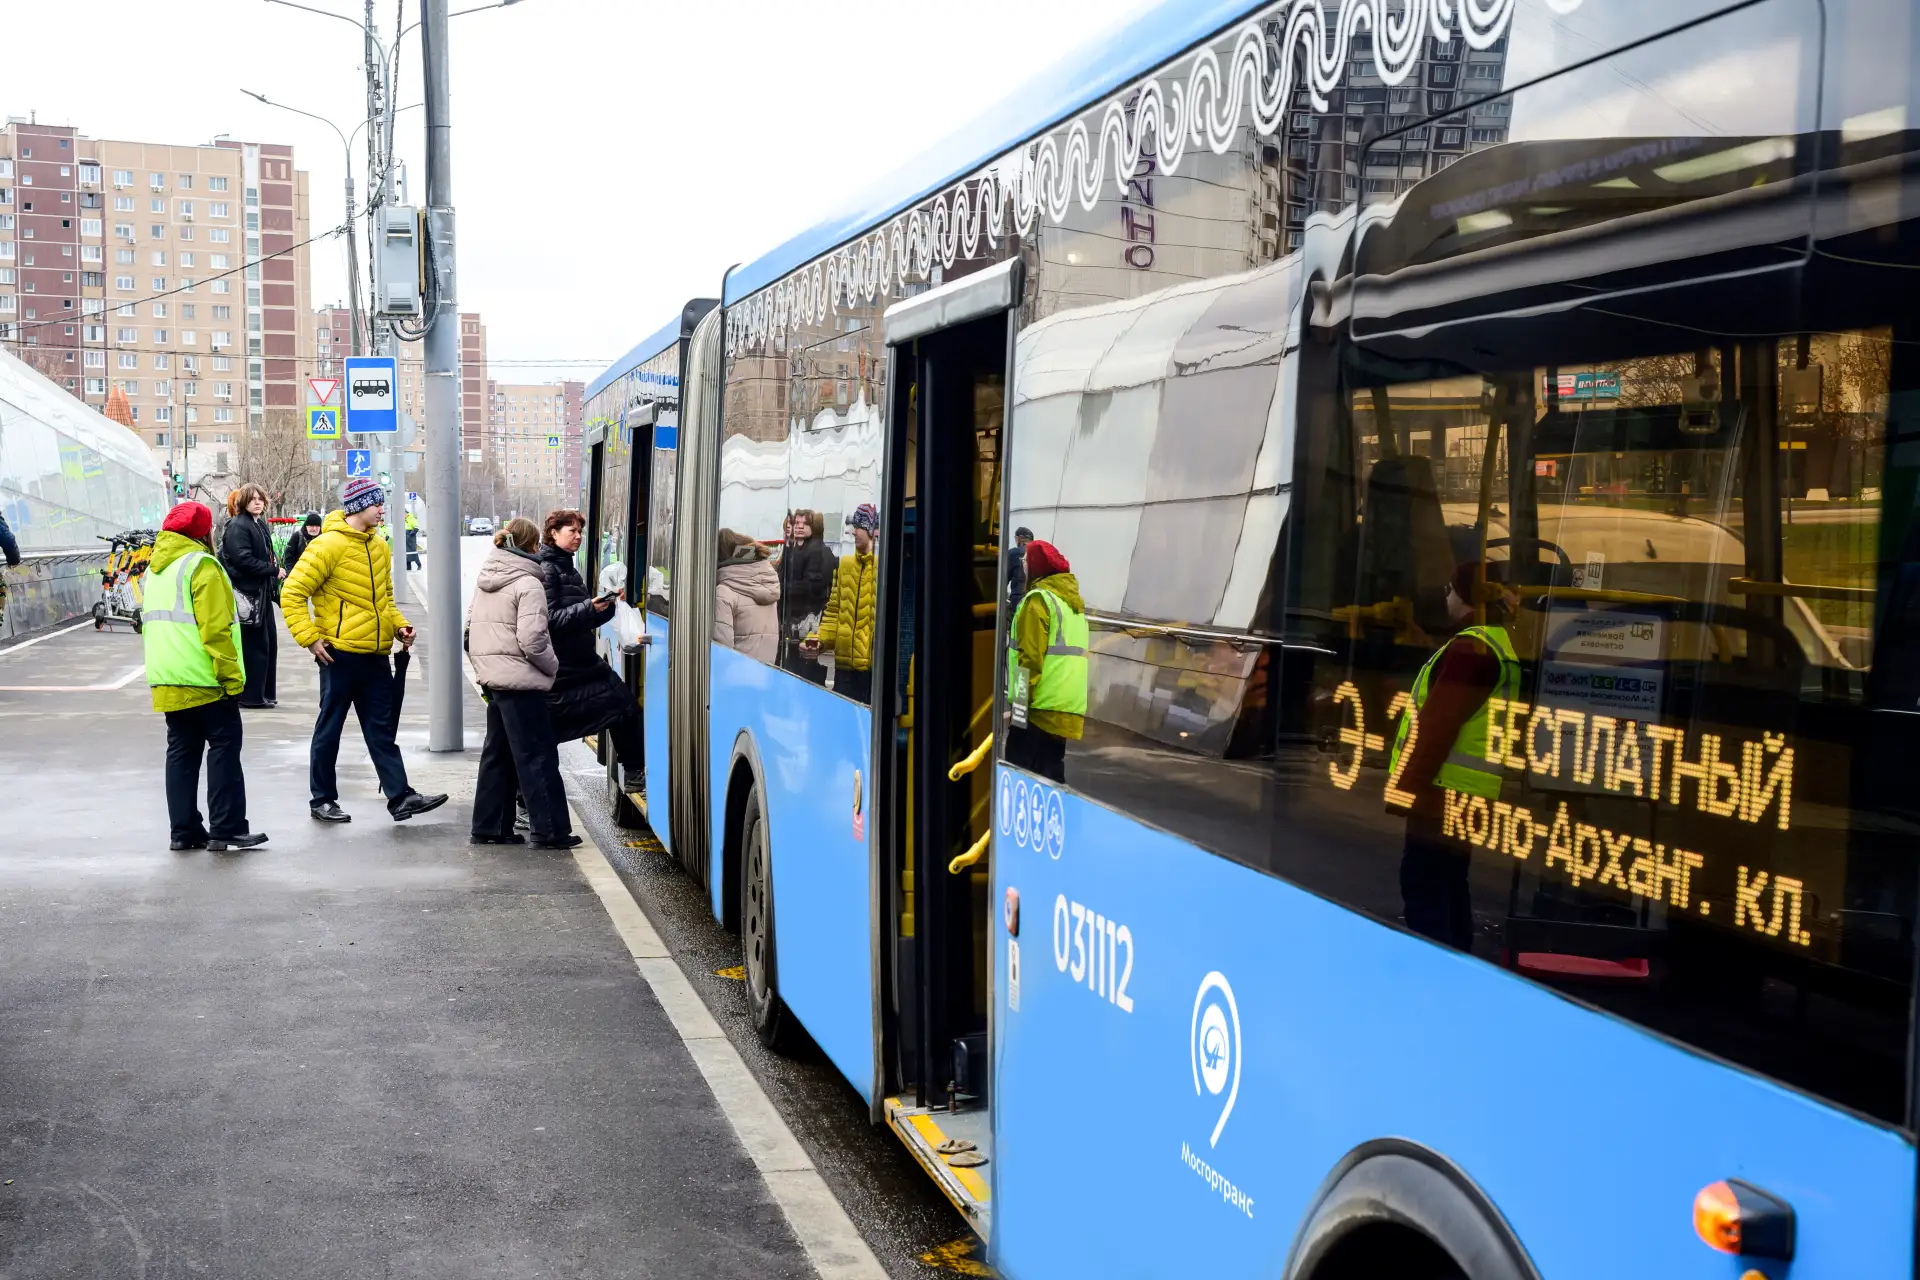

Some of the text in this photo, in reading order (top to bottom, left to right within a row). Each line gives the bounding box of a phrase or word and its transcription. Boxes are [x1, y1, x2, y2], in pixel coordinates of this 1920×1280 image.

[1329, 681, 1420, 809] Э-2
[1485, 697, 1795, 831] БЕСПЛАТНЫЙ
[1053, 894, 1134, 1013] 031112
[1181, 1141, 1254, 1219] Мосгортранс
